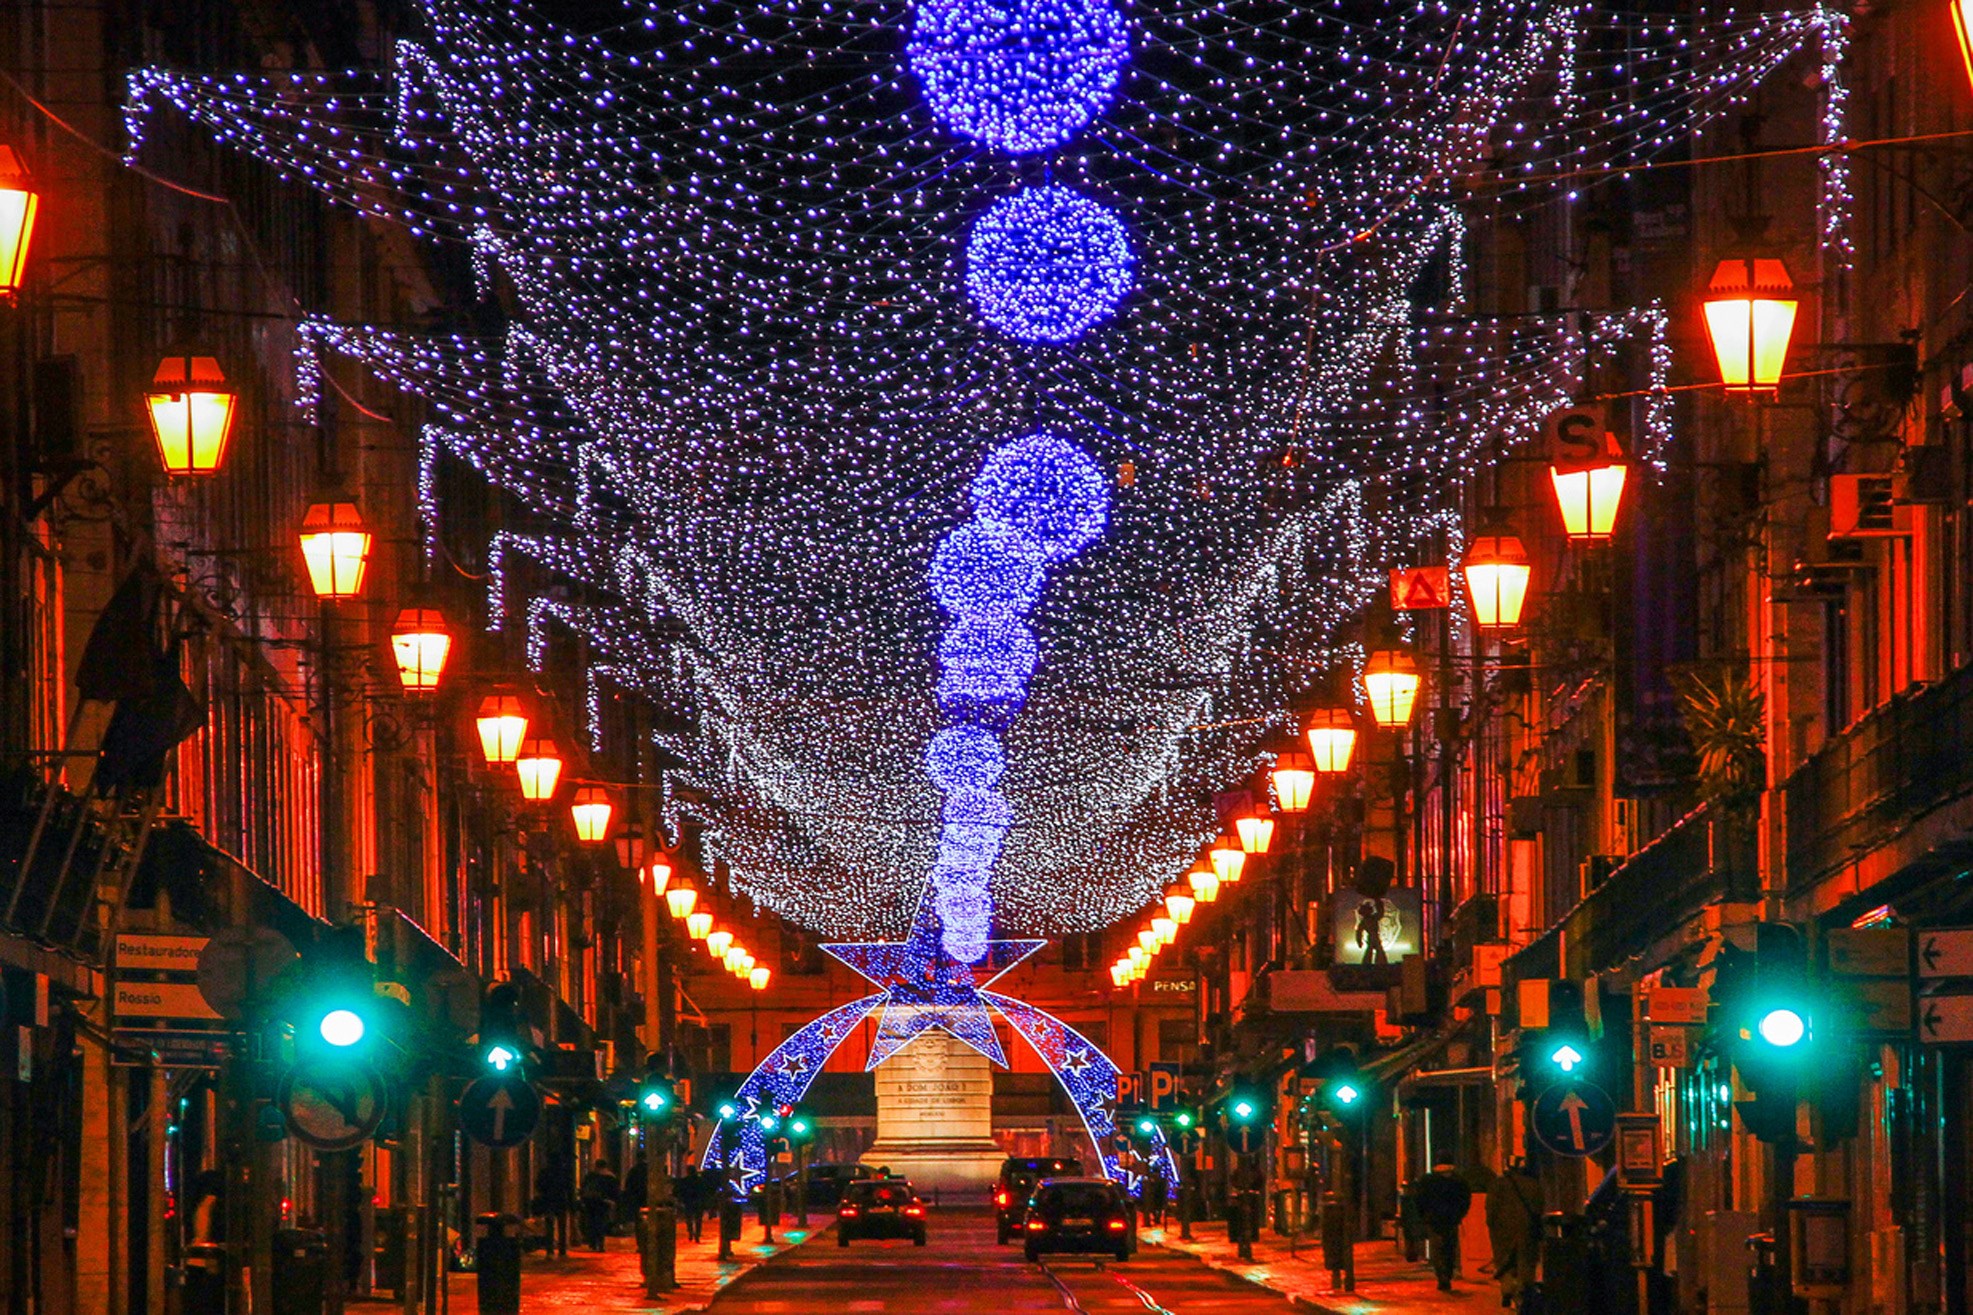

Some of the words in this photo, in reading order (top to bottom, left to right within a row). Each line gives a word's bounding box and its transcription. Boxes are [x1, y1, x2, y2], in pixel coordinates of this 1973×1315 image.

[1558, 414, 1599, 465] S
[119, 943, 200, 958] Restauradore
[119, 991, 161, 1004] Rossio
[1117, 1076, 1132, 1103] P
[1152, 1071, 1172, 1109] P
